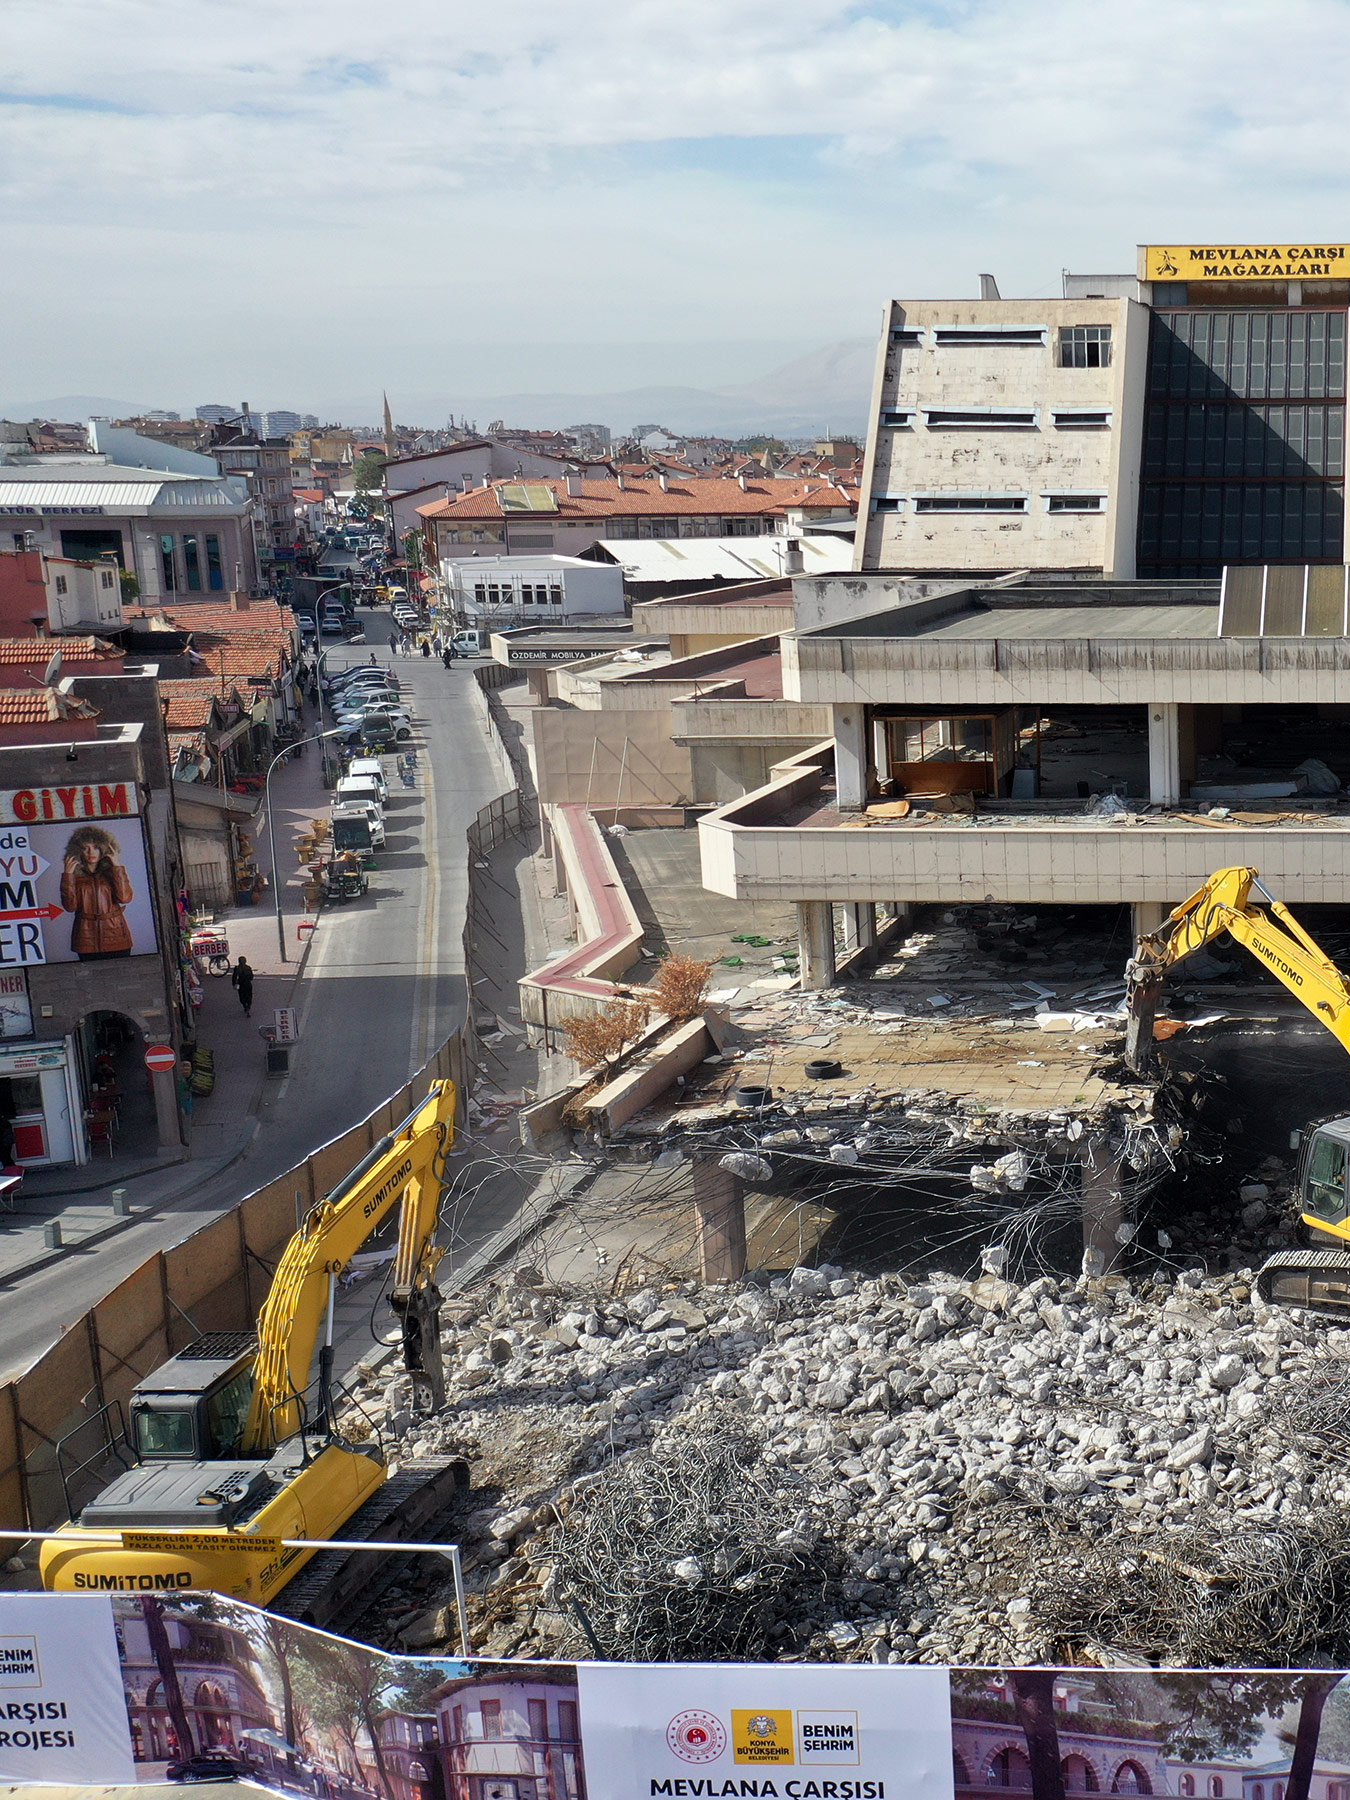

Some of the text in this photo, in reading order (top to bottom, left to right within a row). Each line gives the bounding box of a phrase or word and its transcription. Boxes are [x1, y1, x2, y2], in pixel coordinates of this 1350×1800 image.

[1189, 247, 1345, 262] MEVLANA ÇARŞI
[1203, 262, 1330, 276] MAĞAZALARI
[41, 505, 103, 514] MERKEZİ
[511, 650, 547, 659] ÖZDEMİR
[194, 943, 228, 956] BERBER
[1251, 937, 1304, 987] SUMITOMO
[363, 1158, 413, 1219] SUMITOMO
[192, 1536, 219, 1544] 2,00
[221, 1537, 276, 1545] METREDEN
[737, 1746, 789, 1756] BÜYÜKŞEHİR
[650, 1779, 885, 1800] MEVLANA ÇARŞISI
